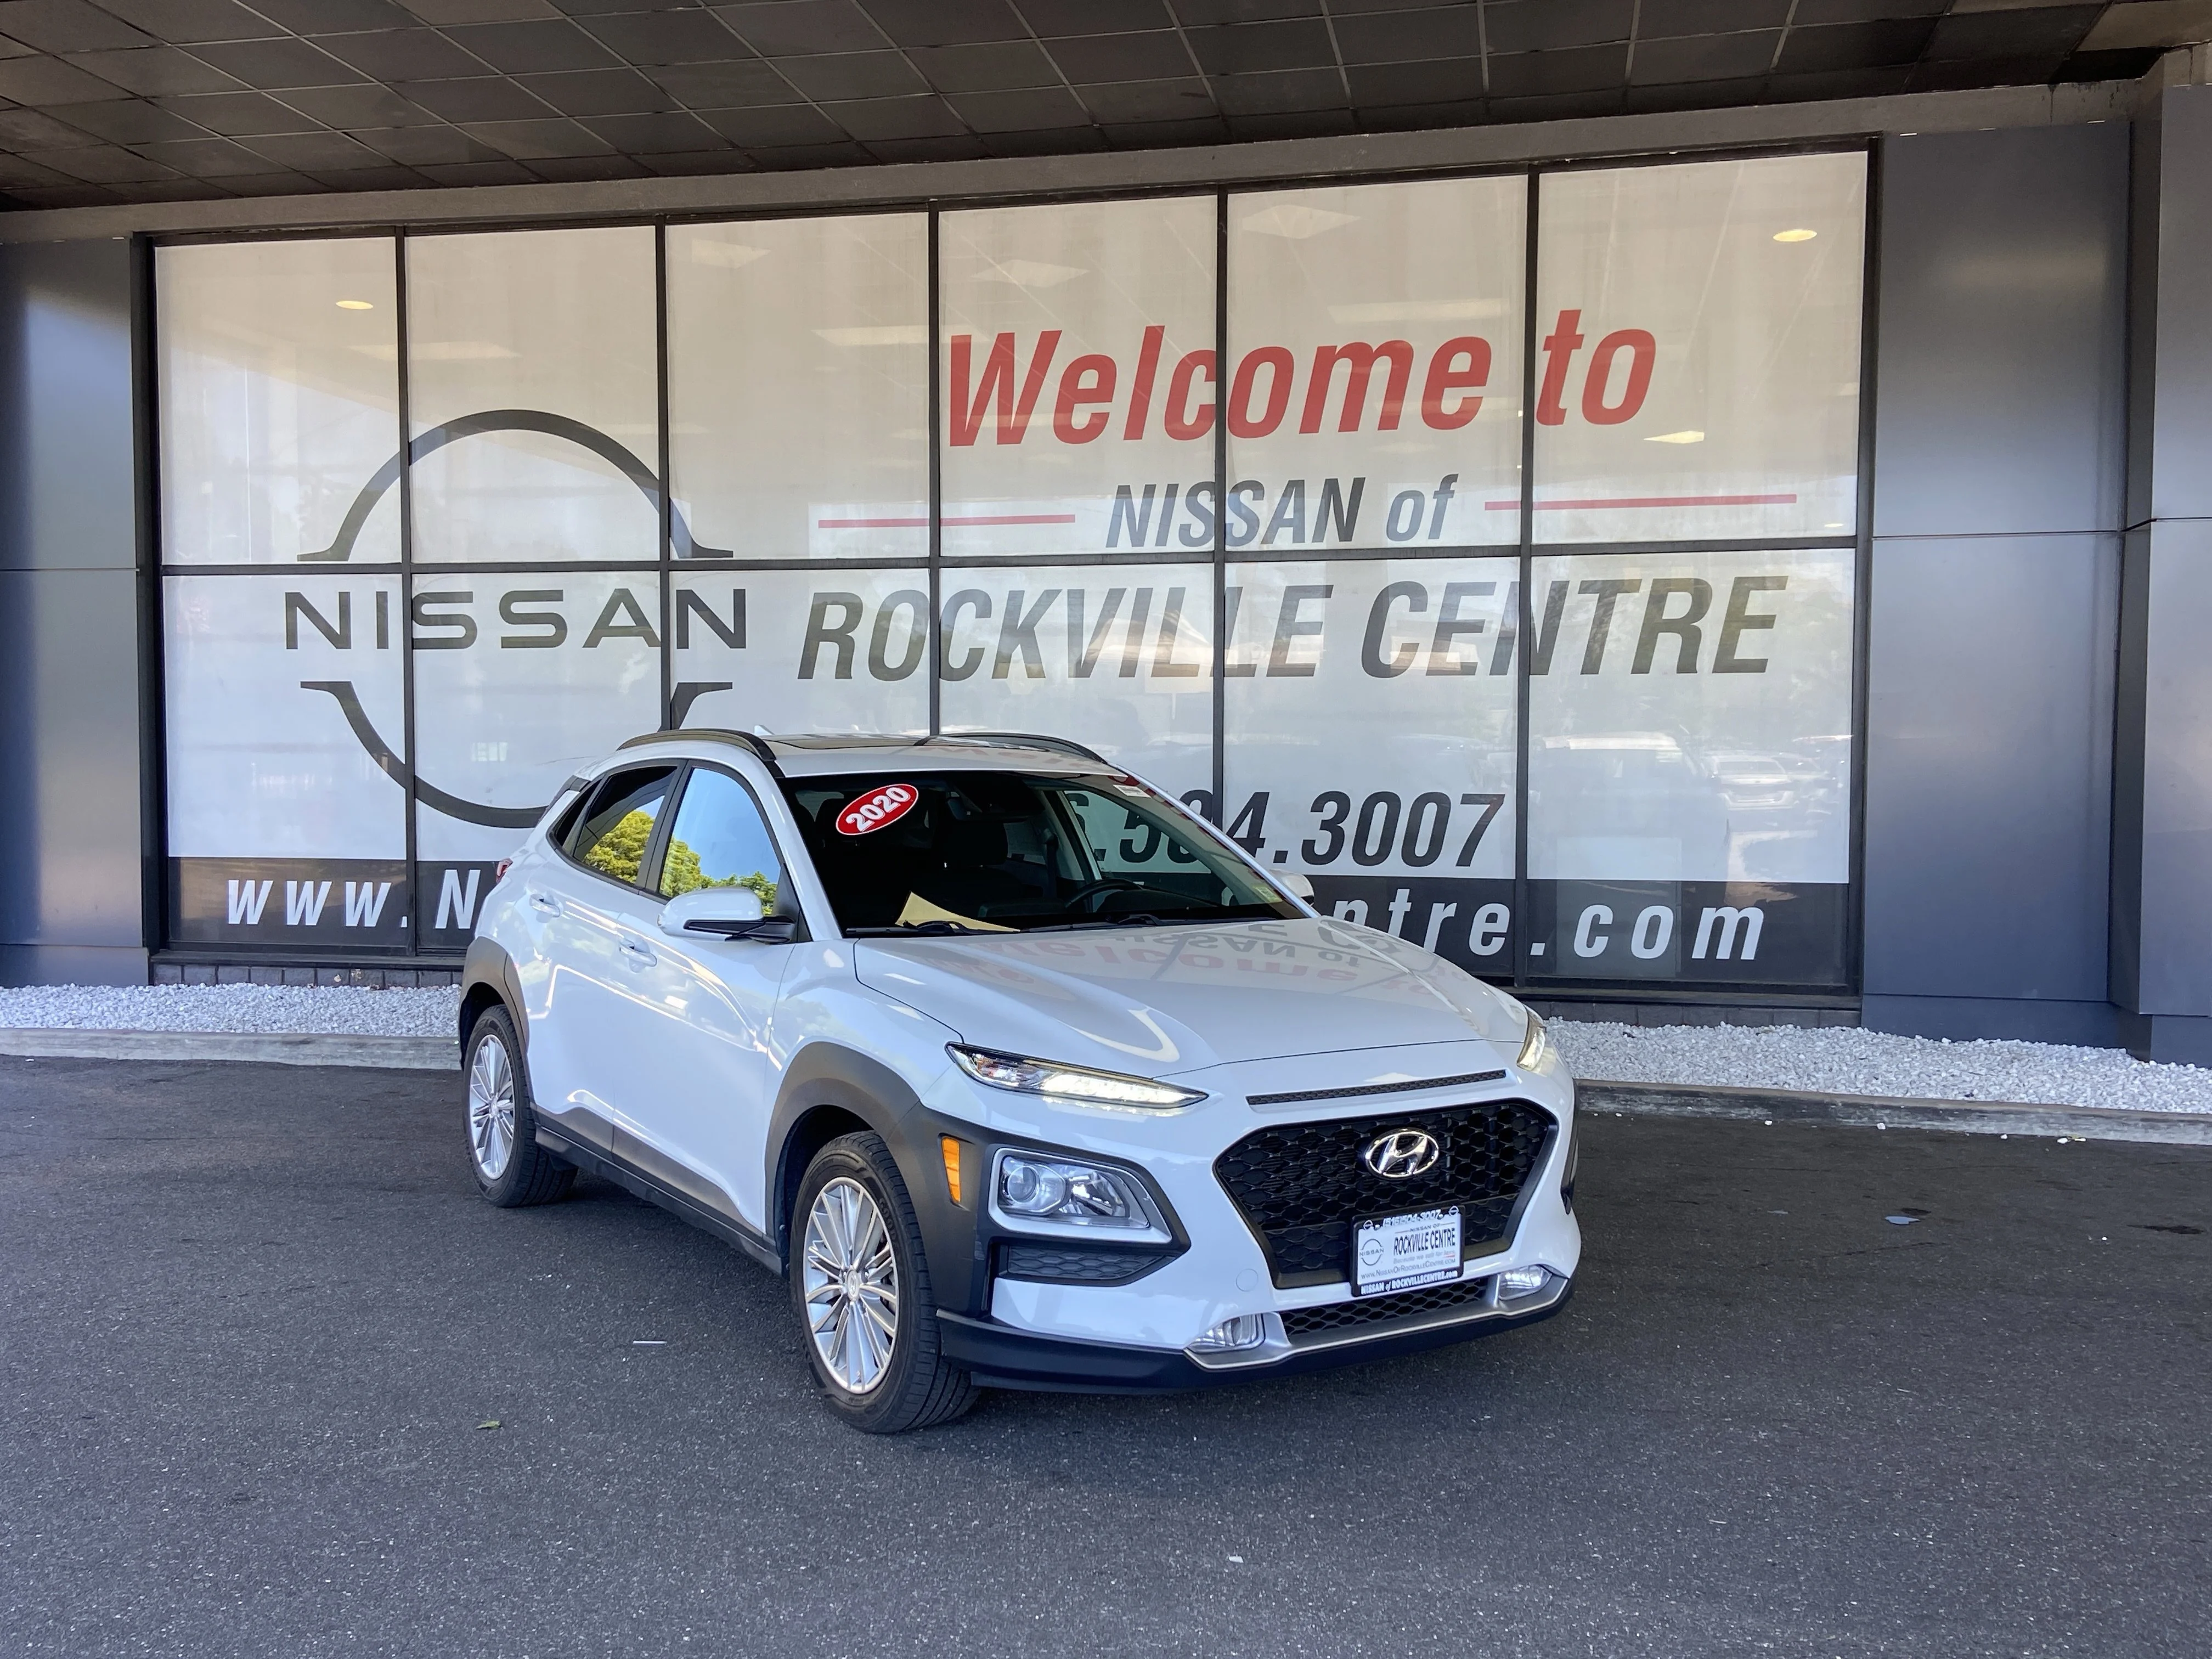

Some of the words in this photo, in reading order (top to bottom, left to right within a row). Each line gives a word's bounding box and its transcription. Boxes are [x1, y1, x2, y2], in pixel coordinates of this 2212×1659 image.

[949, 325, 1492, 447] Welcome
[1534, 309, 1656, 426] to
[1105, 477, 1366, 549] NISSAN
[1385, 473, 1458, 542] of
[284, 588, 746, 650] NISSAN
[797, 584, 1334, 681] ROCKVILLE
[1360, 575, 1790, 679] CENTRE
[845, 787, 911, 832] 2020
[227, 869, 481, 930] www.N
[1333, 888, 1765, 960] ntre.com
[1359, 1248, 1384, 1257] NISSAN
[1393, 1231, 1429, 1255] ROCKVILLE
[1430, 1228, 1455, 1250] CENTRE
[1361, 1282, 1385, 1295] NISSAN
[1385, 1282, 1392, 1292] of
